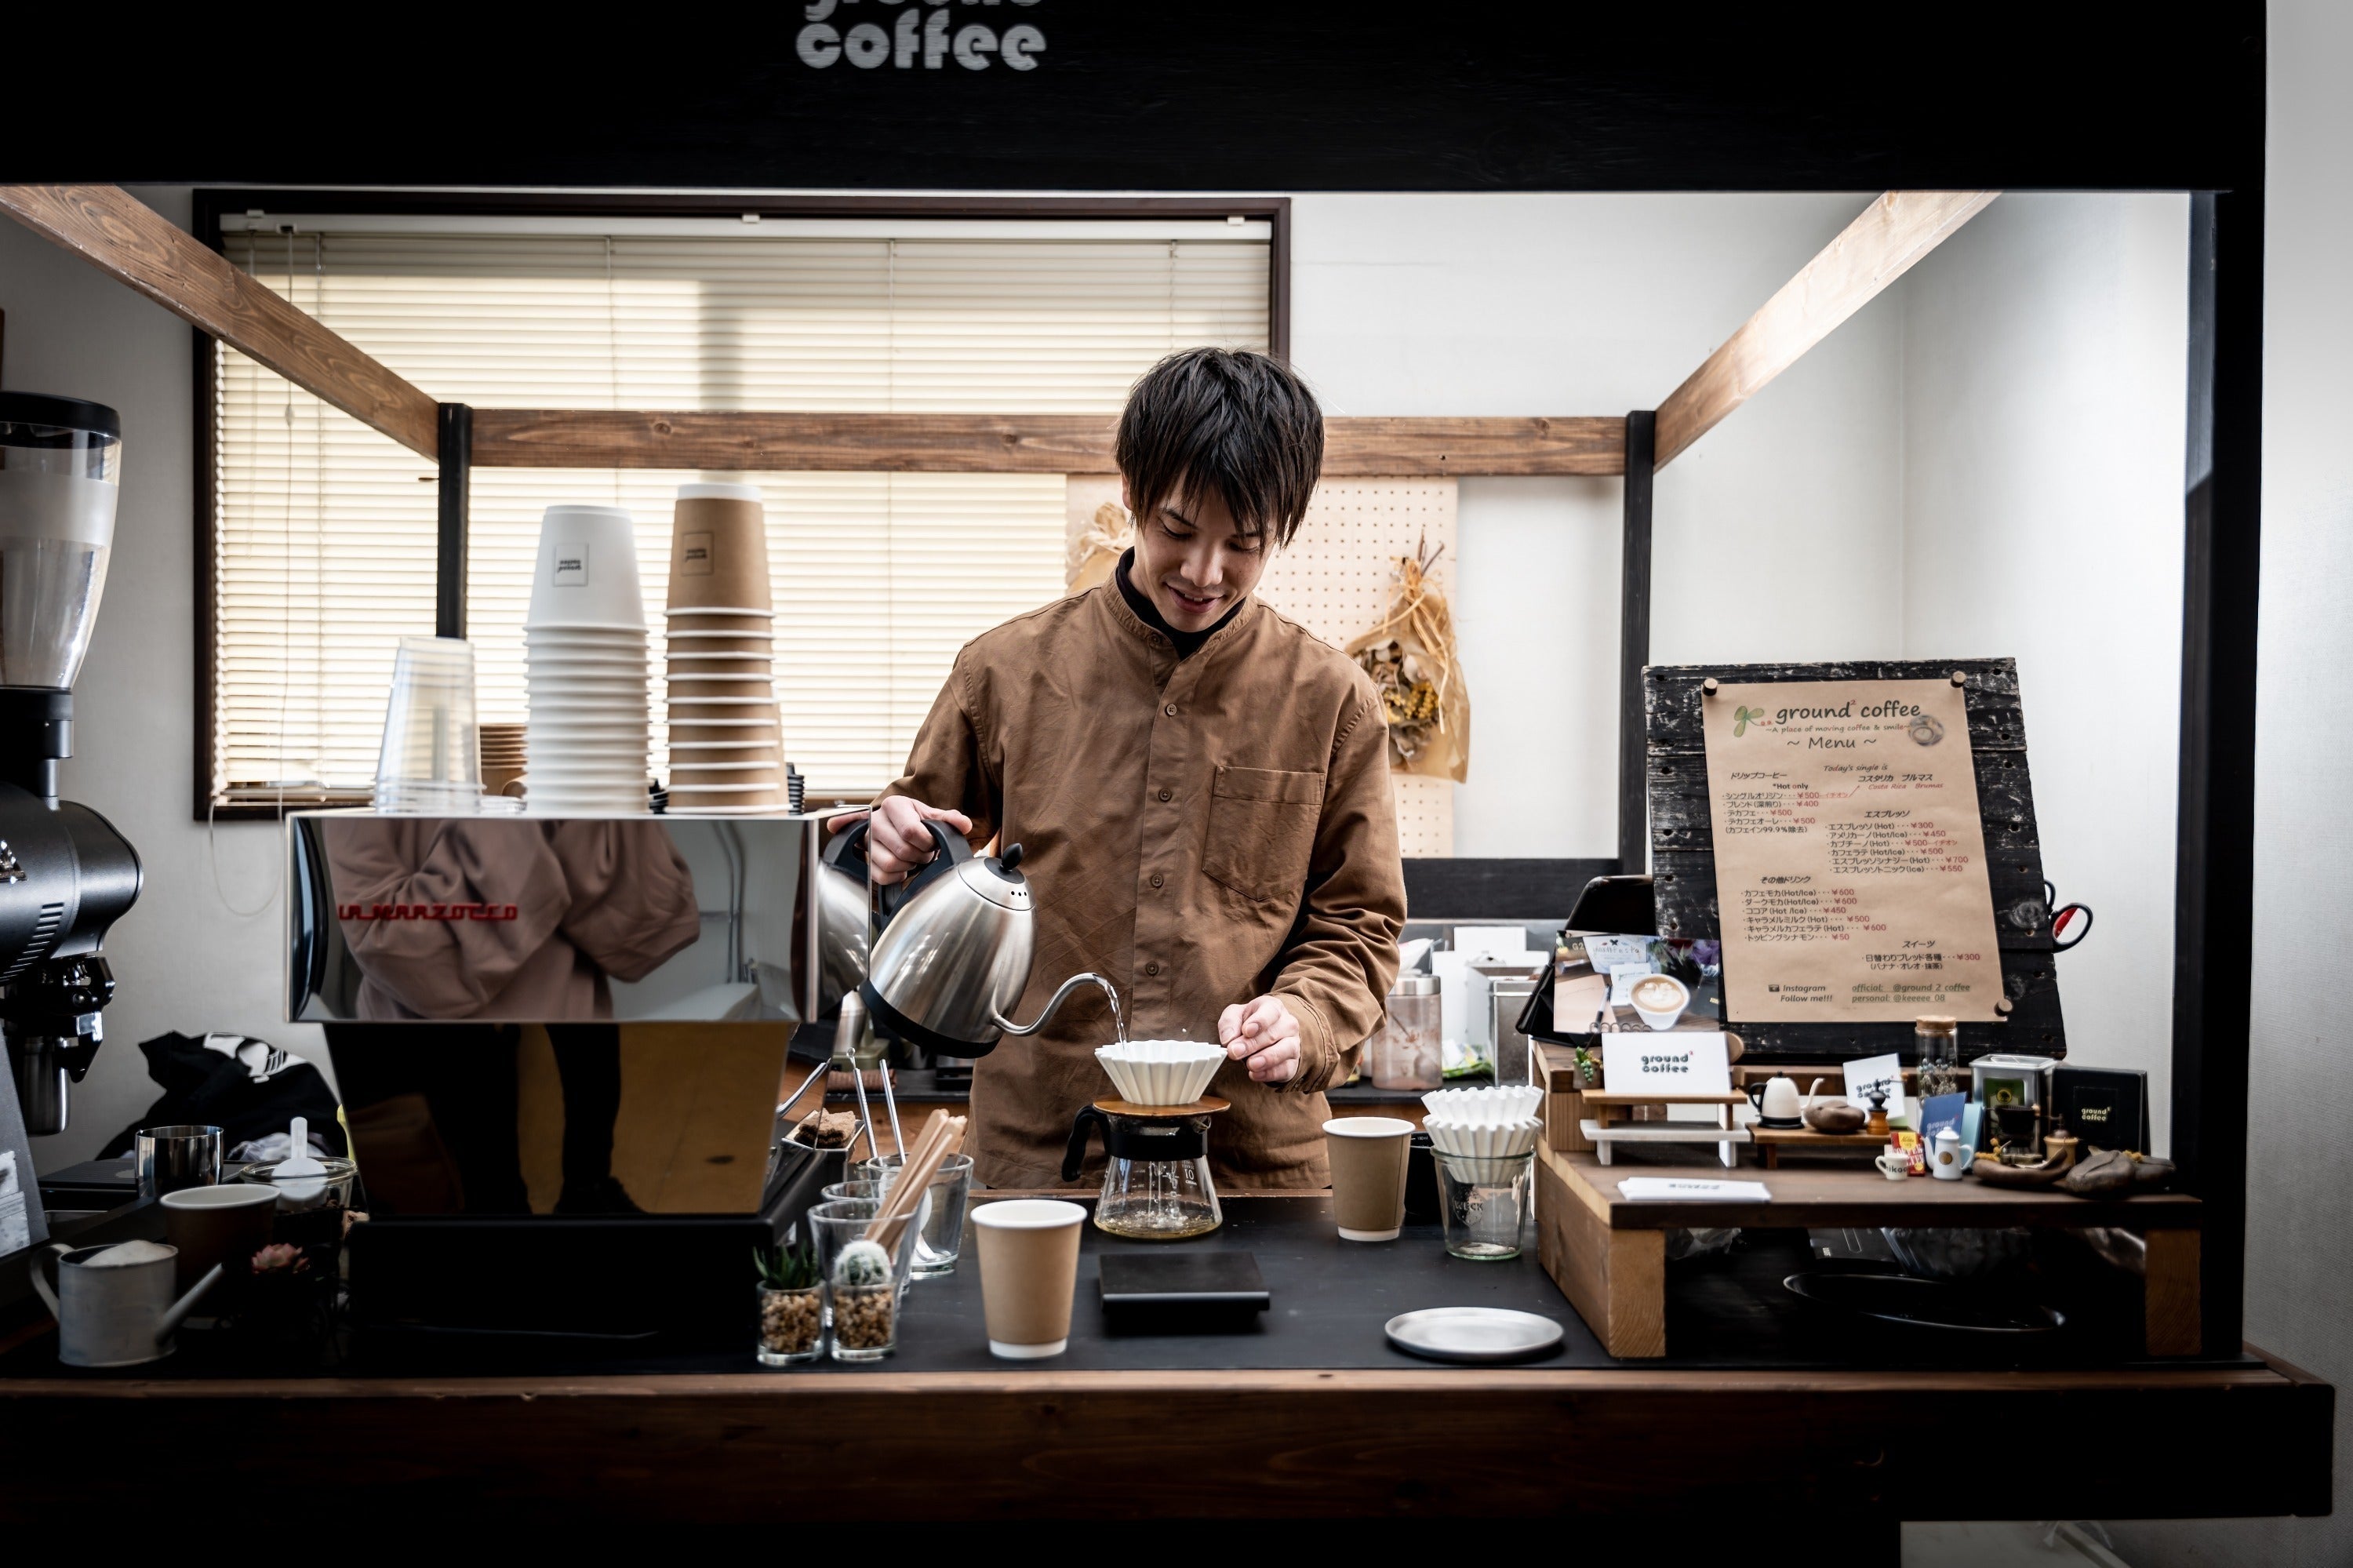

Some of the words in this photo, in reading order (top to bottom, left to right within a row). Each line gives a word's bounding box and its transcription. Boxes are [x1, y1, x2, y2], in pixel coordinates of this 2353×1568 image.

[796, 8, 1046, 71] coffee
[1860, 700, 1920, 718] coffee
[1781, 726, 1802, 734] place
[1815, 725, 1845, 733] moving
[1809, 737, 1856, 749] Menu
[1856, 765, 1878, 773] single
[1858, 773, 1893, 782] コスタリカ
[1760, 875, 1811, 884] その他ドリンク
[1902, 940, 1936, 949] スイーツ
[1783, 984, 1826, 993] Instagram
[1852, 995, 1889, 1003] personal:
[1642, 1062, 1689, 1073] coffee
